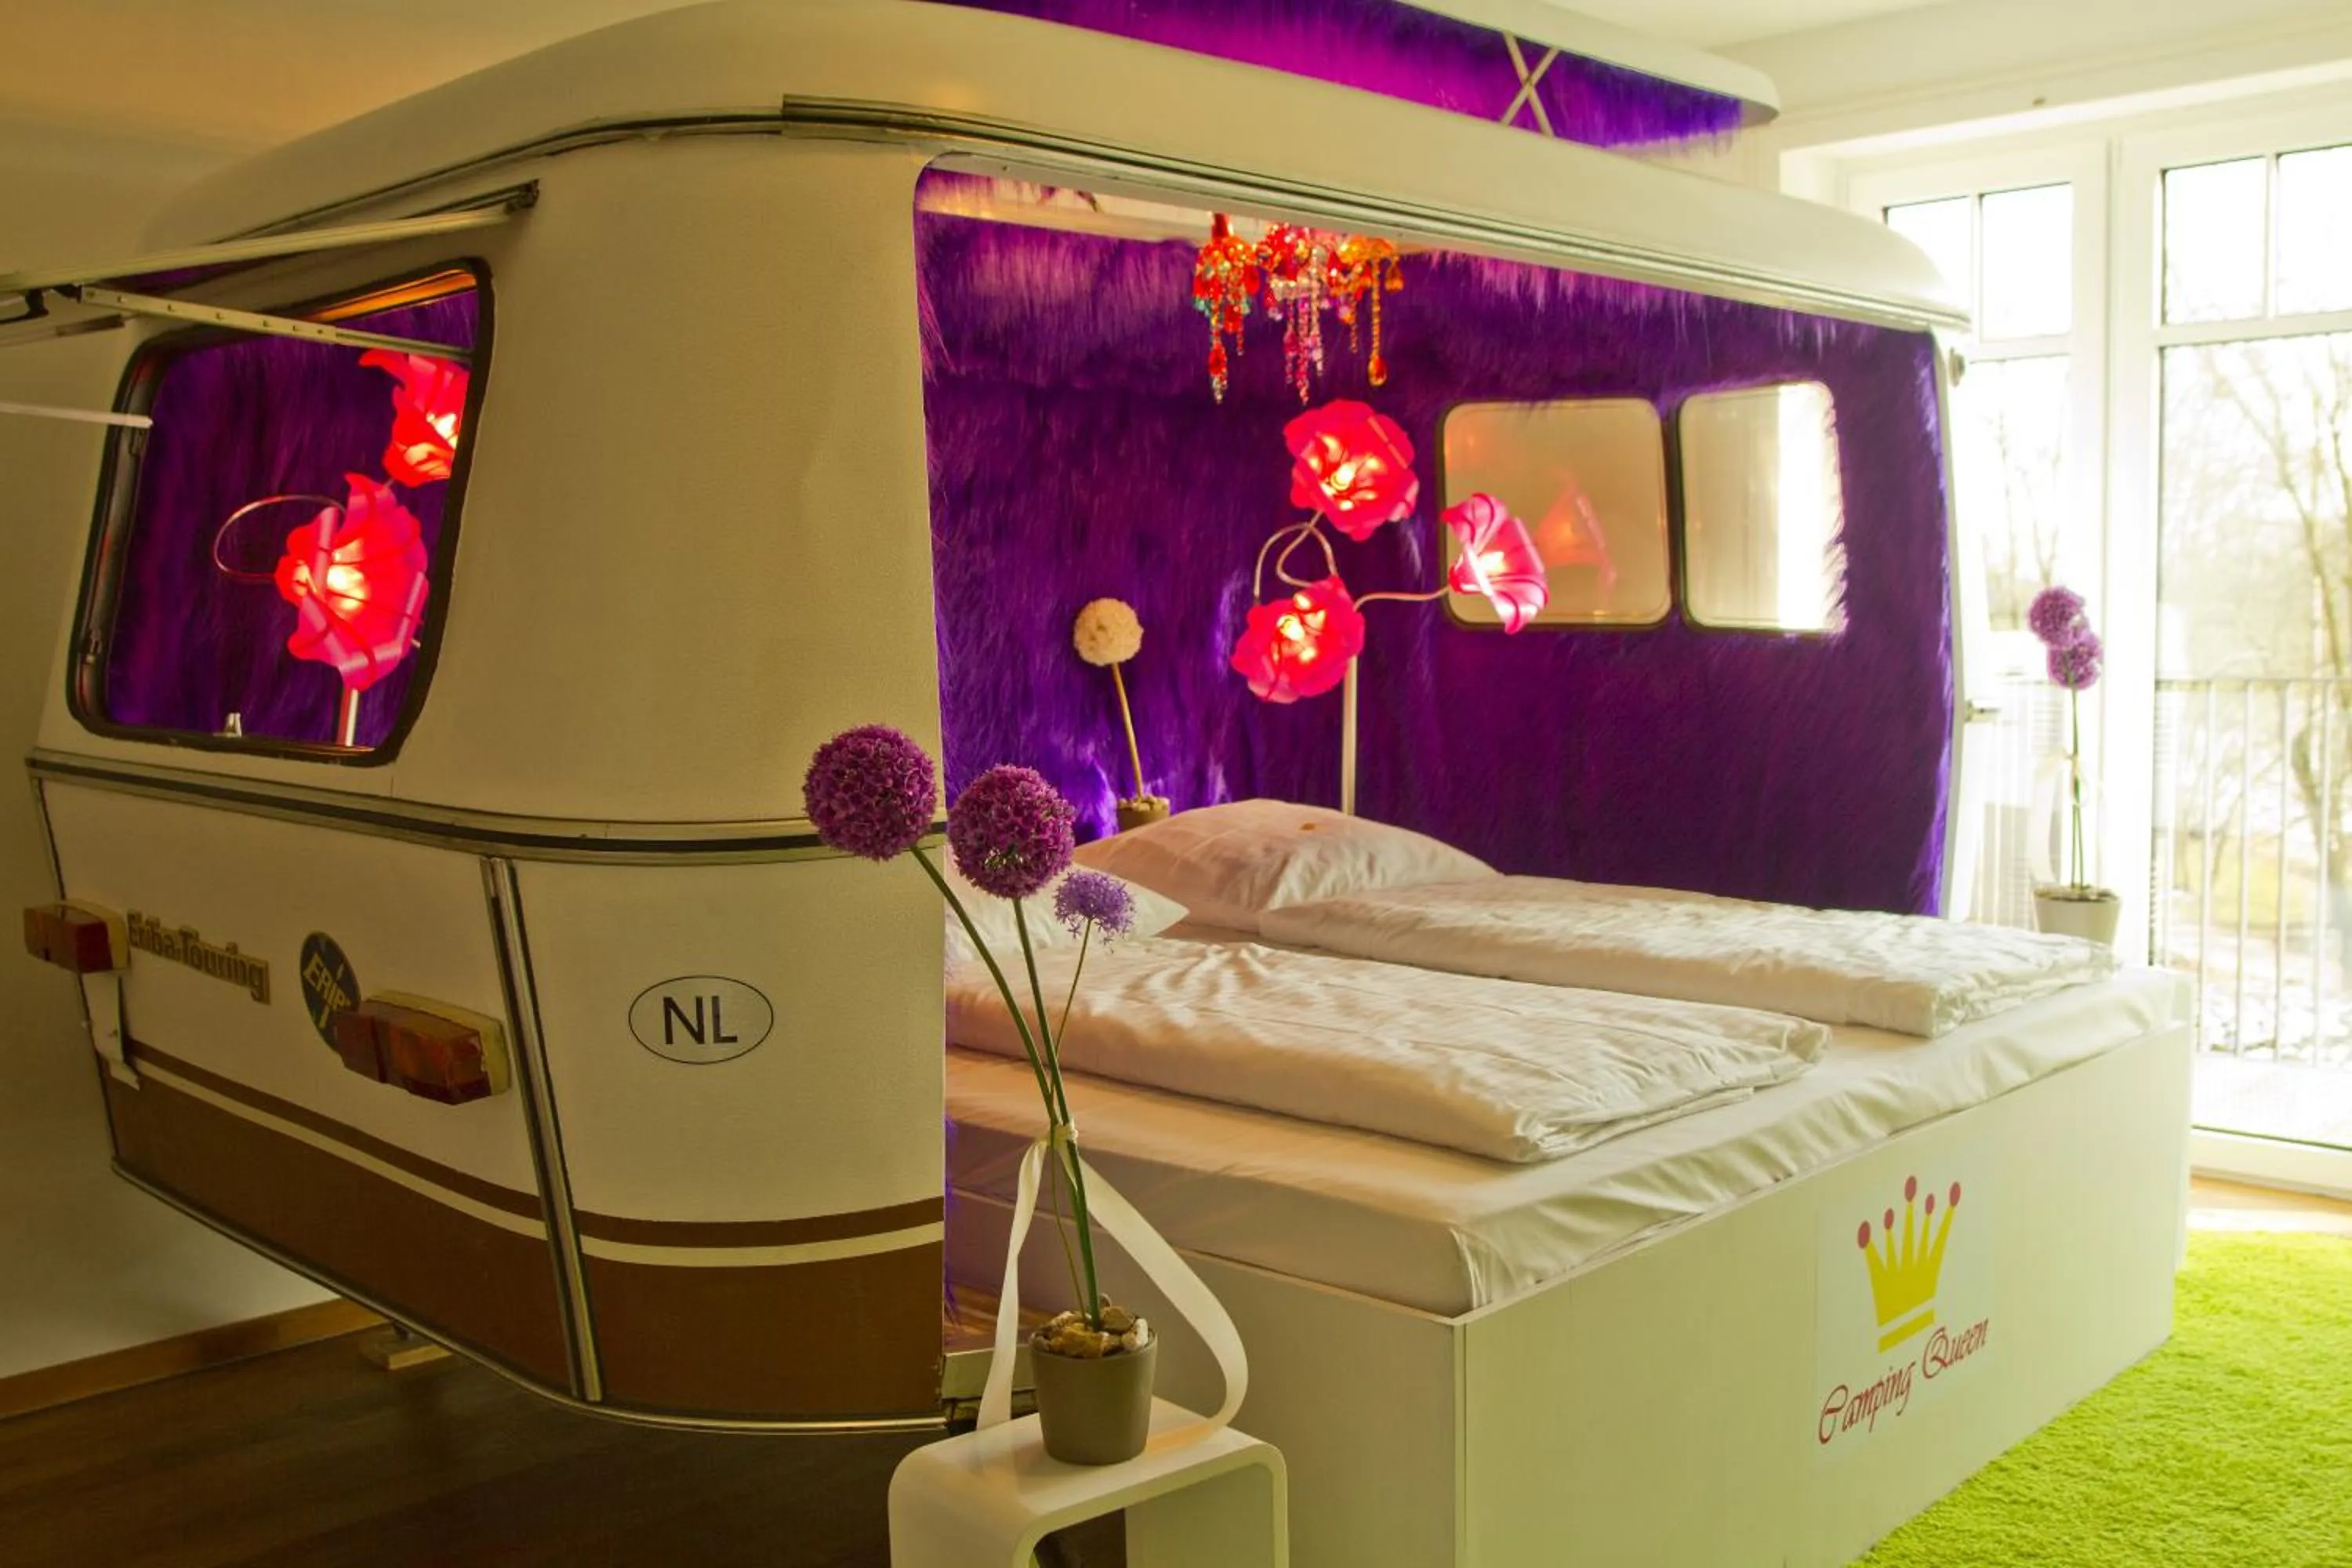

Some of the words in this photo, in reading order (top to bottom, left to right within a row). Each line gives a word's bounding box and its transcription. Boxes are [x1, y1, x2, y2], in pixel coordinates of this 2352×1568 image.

[662, 995, 738, 1045] NL
[1818, 1362, 1916, 1444] Camping
[1922, 1317, 1989, 1379] Queen
